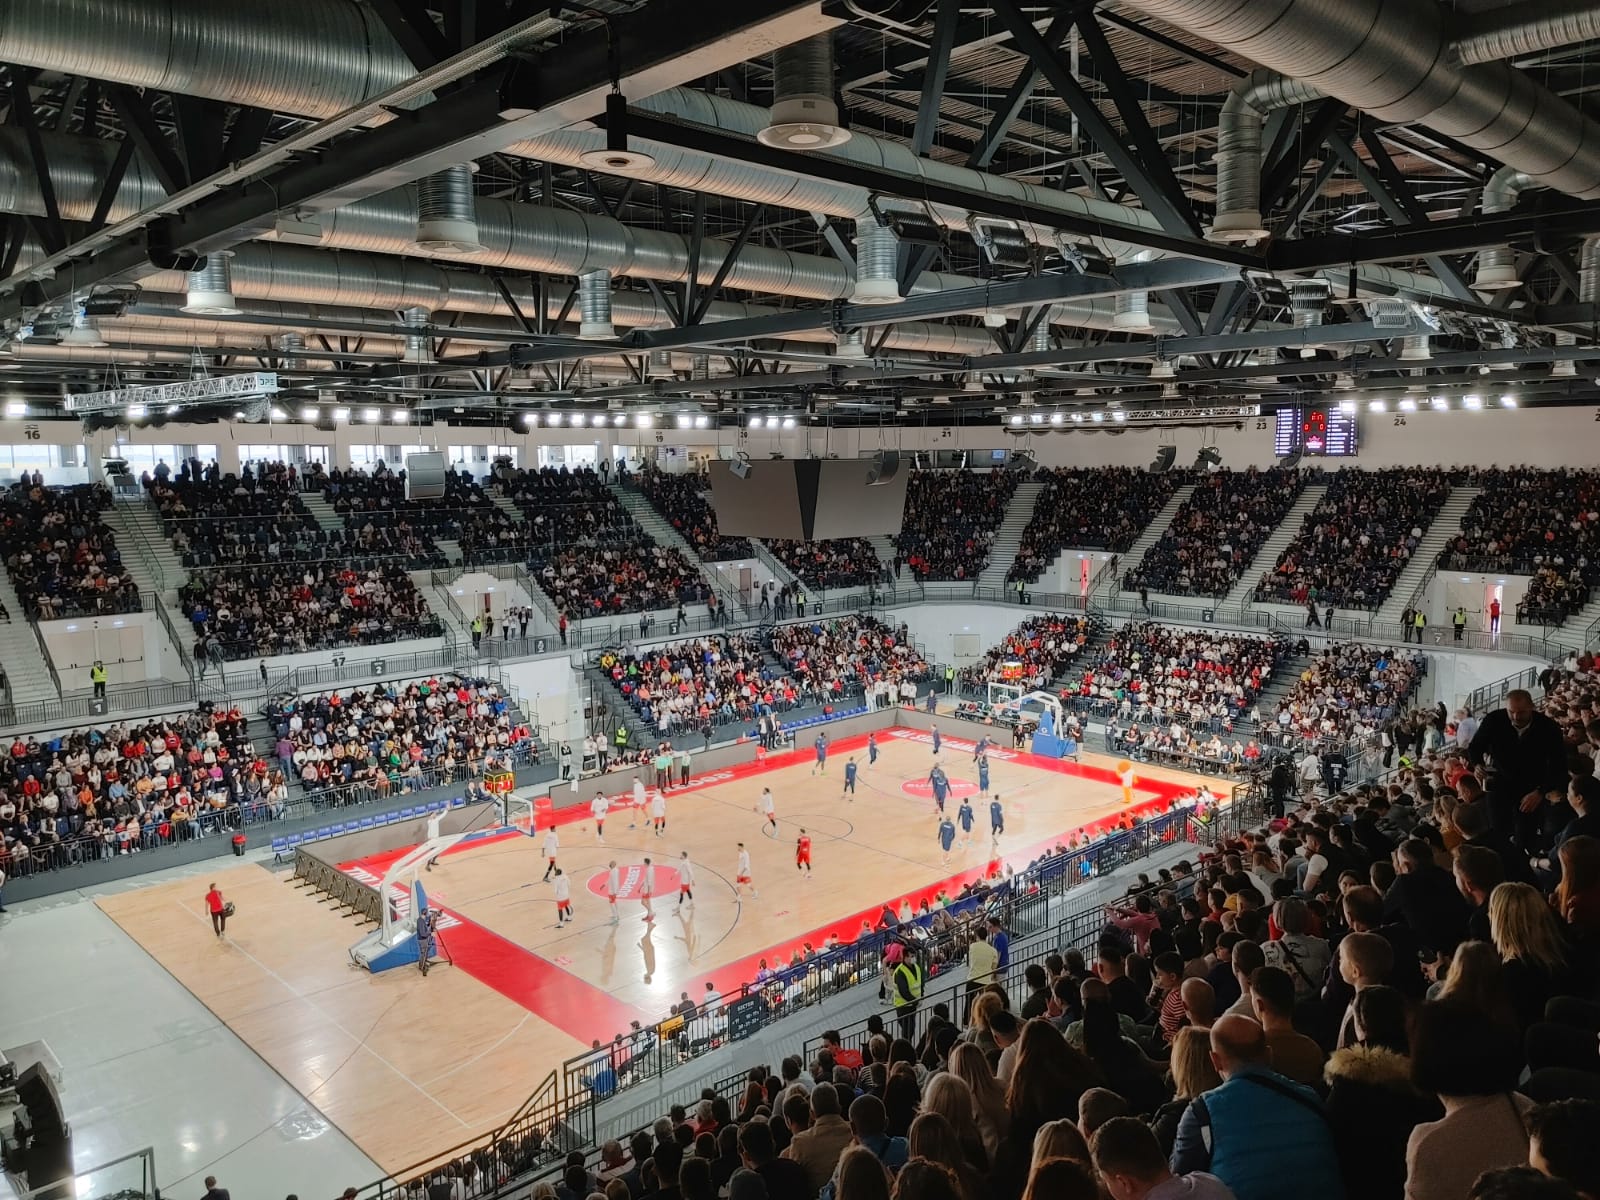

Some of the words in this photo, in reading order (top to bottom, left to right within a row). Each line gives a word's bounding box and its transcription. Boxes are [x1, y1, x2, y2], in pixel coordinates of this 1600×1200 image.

[1256, 422, 1267, 430] 23
[1393, 418, 1407, 426] 24
[24, 430, 41, 440] 16
[655, 435, 664, 443] 19
[331, 656, 346, 667] 17
[375, 666, 382, 674] 2
[94, 703, 102, 713] 1
